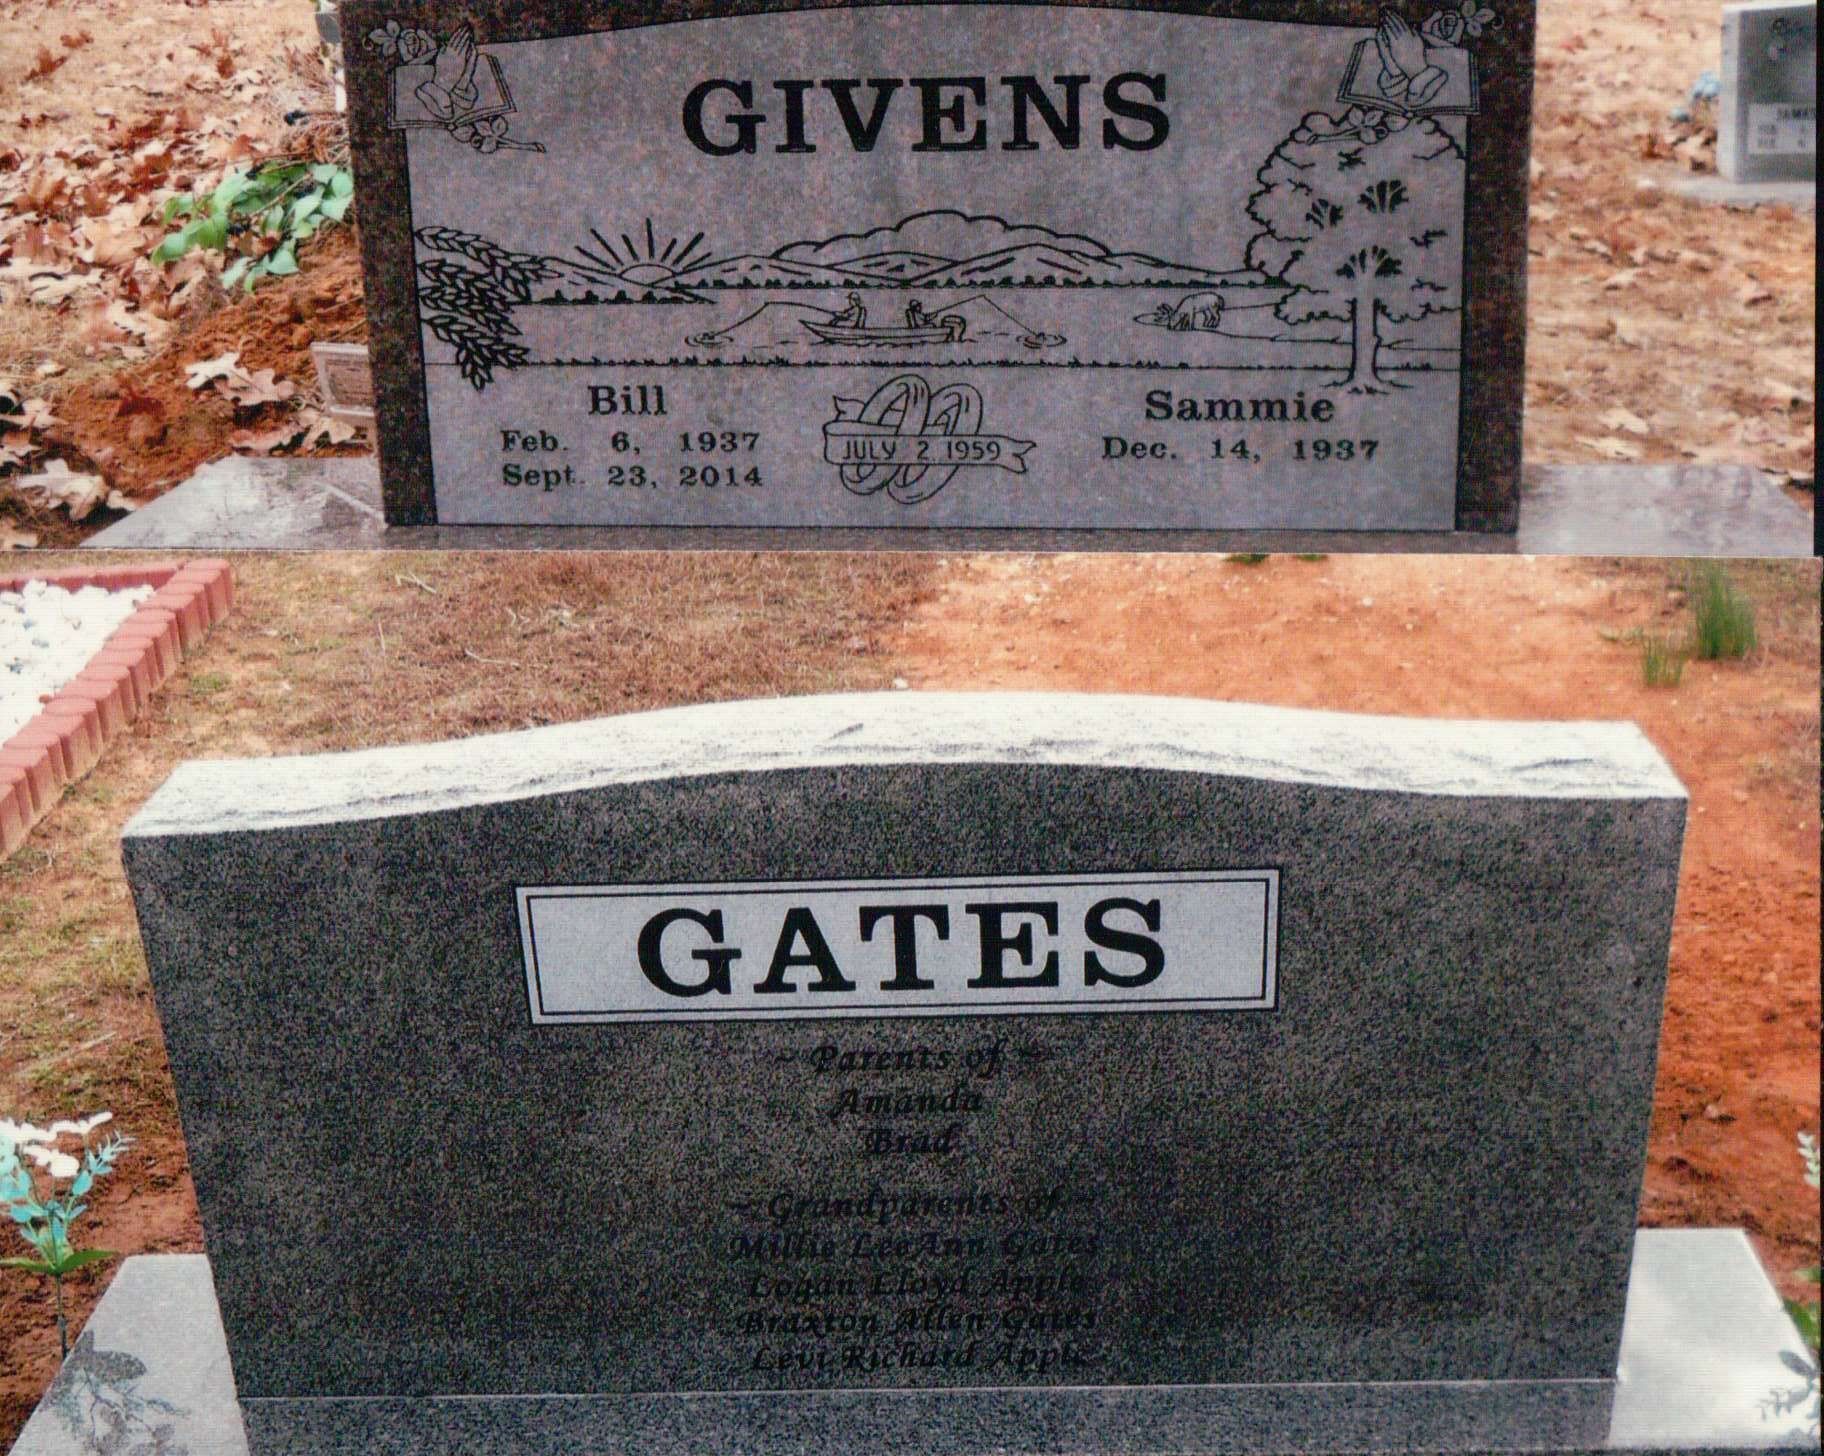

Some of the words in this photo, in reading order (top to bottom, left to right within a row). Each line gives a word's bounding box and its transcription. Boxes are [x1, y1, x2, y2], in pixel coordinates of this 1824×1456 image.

[682, 71, 1170, 157] GIVENS
[587, 384, 668, 416] Bill
[1145, 389, 1336, 422] Sammie
[500, 430, 569, 453] Feb.
[611, 431, 641, 455] 6,
[679, 431, 761, 453] 1937
[842, 440, 897, 461] JULY
[947, 440, 1001, 461] 1959
[1101, 436, 1178, 460] Dec.
[1210, 438, 1262, 464] 14,
[1293, 439, 1379, 461] 1937
[502, 463, 587, 493] Sept.
[606, 465, 658, 490] 23,
[679, 464, 764, 488] 2014
[637, 897, 1166, 998] GATES
[808, 1044, 951, 1074] Parents
[965, 1038, 1010, 1078] of
[828, 1082, 984, 1121] Amanda
[866, 1123, 962, 1155] Brad
[768, 1188, 1010, 1228] Grandparents
[728, 1231, 836, 1261] Millie
[750, 1271, 856, 1305] Logan
[737, 1309, 879, 1340] Braxton
[843, 1342, 981, 1374] Richard
